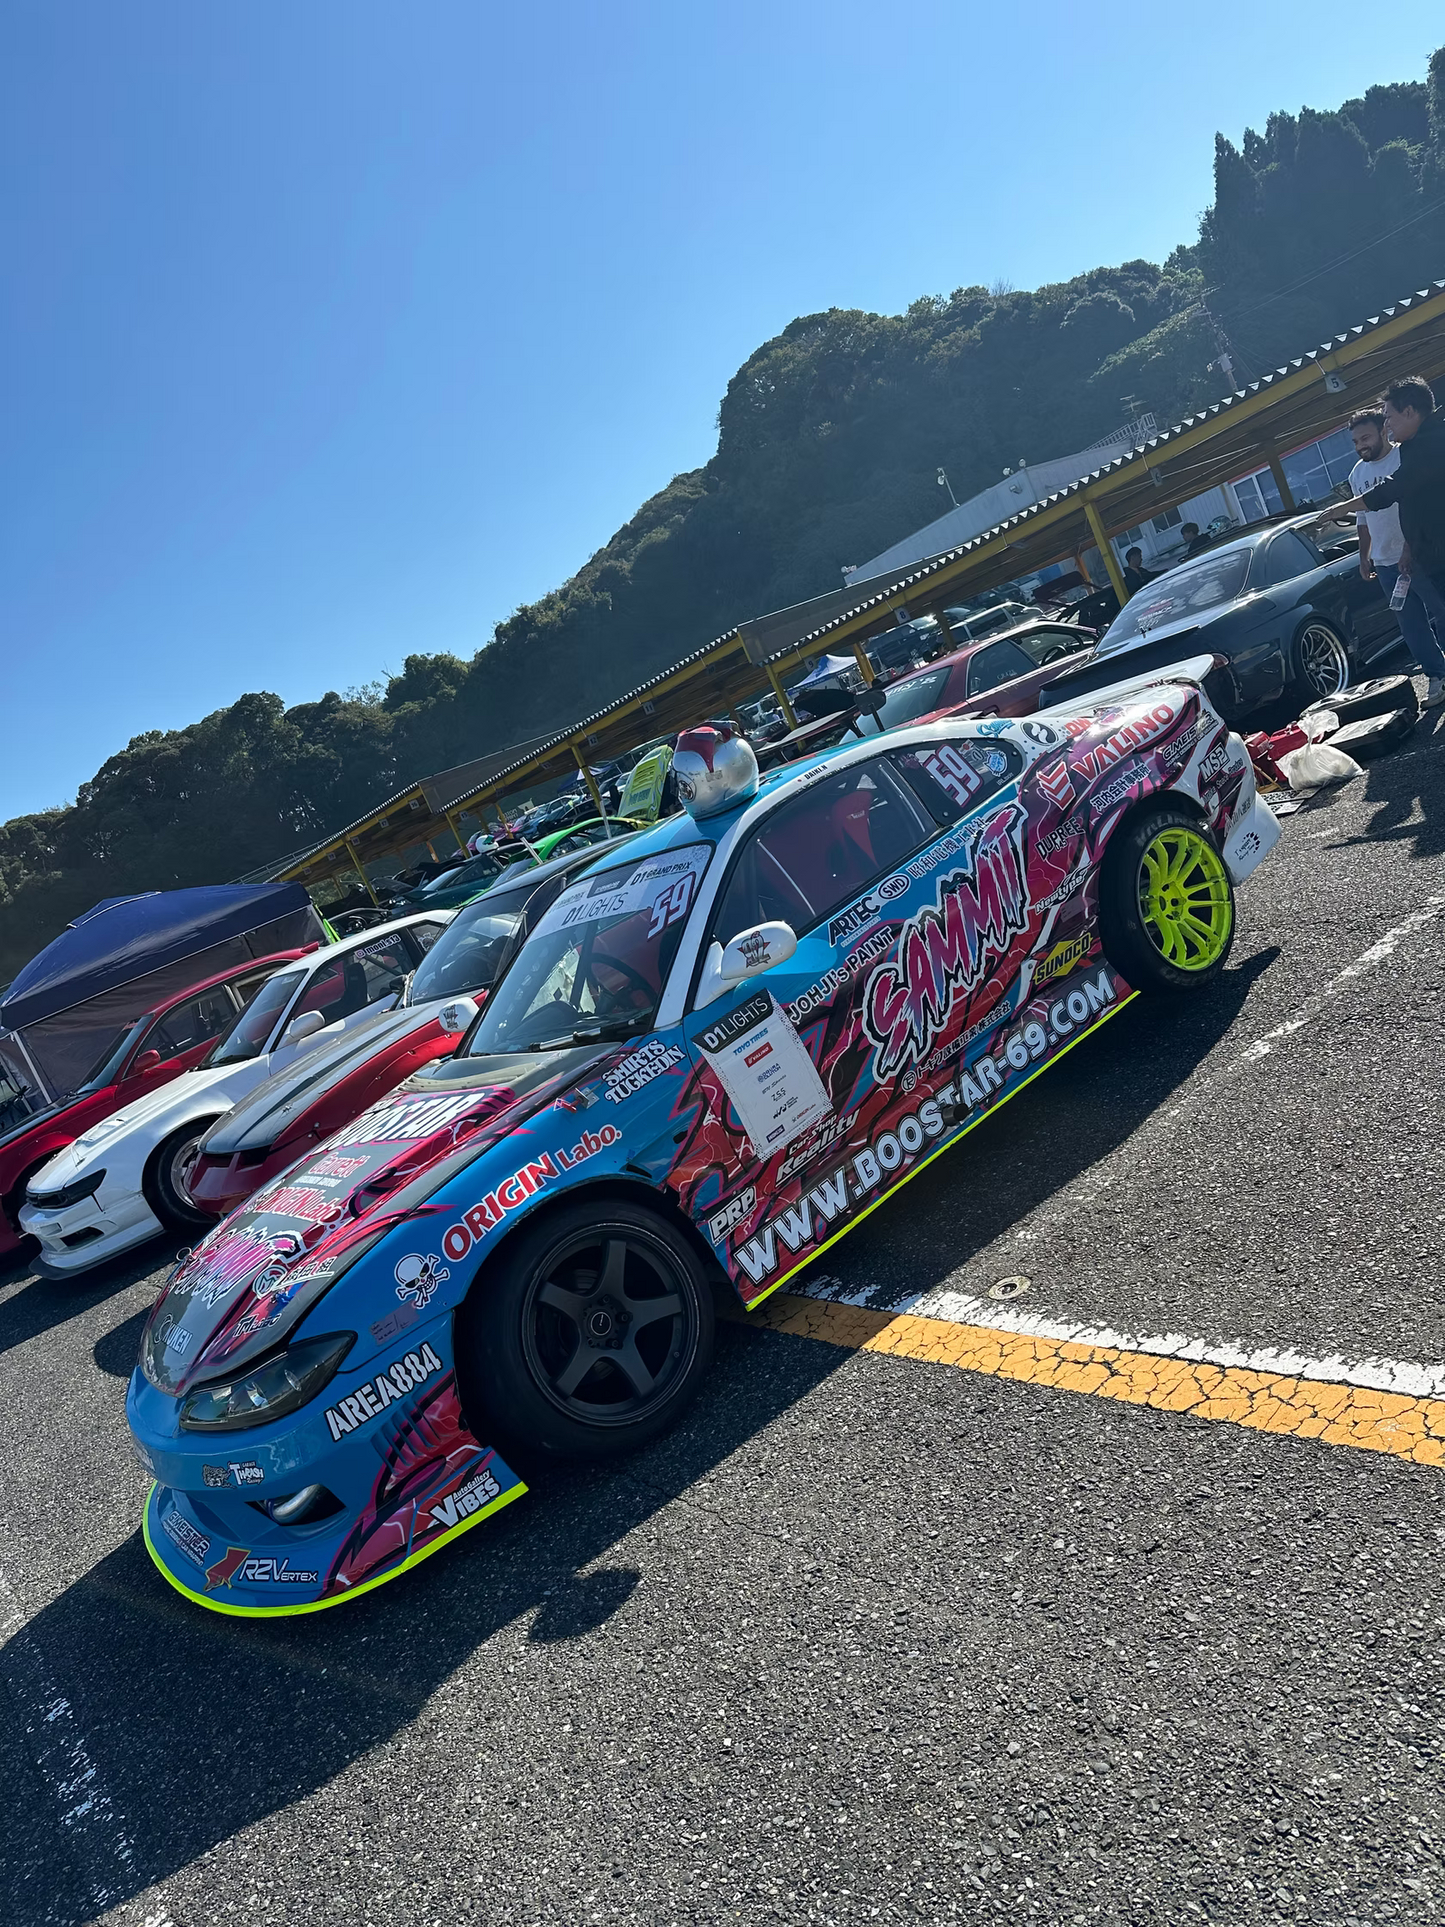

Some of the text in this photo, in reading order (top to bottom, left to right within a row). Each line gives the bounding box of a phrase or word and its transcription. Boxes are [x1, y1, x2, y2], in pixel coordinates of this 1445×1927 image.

[1331, 378, 1339, 389] 5
[1070, 703, 1174, 783] VALINO
[923, 744, 983, 808] 59
[1089, 762, 1151, 814] 河内会計事務所
[1035, 817, 1085, 860] DUPREE
[648, 871, 697, 942] 59
[881, 877, 908, 898] SWD
[828, 896, 881, 947] ARTEC
[867, 803, 1026, 1080] SAMMIT
[846, 926, 895, 976] PAINT
[1034, 933, 1090, 985] SUNOCO
[602, 1039, 666, 1088] SHIRTS
[732, 1027, 769, 1057] TOYO TIRES
[605, 1044, 686, 1106] TUCKEDIN
[734, 968, 1117, 1286] WWW.BOOSTAR-69.COM
[776, 1109, 861, 1184] Reality
[442, 1151, 562, 1263] ORIGIN
[711, 1187, 757, 1240] PRP
[164, 1324, 193, 1355] KUKEN
[323, 1342, 443, 1442] AREA884
[429, 1477, 501, 1528] VIBES
